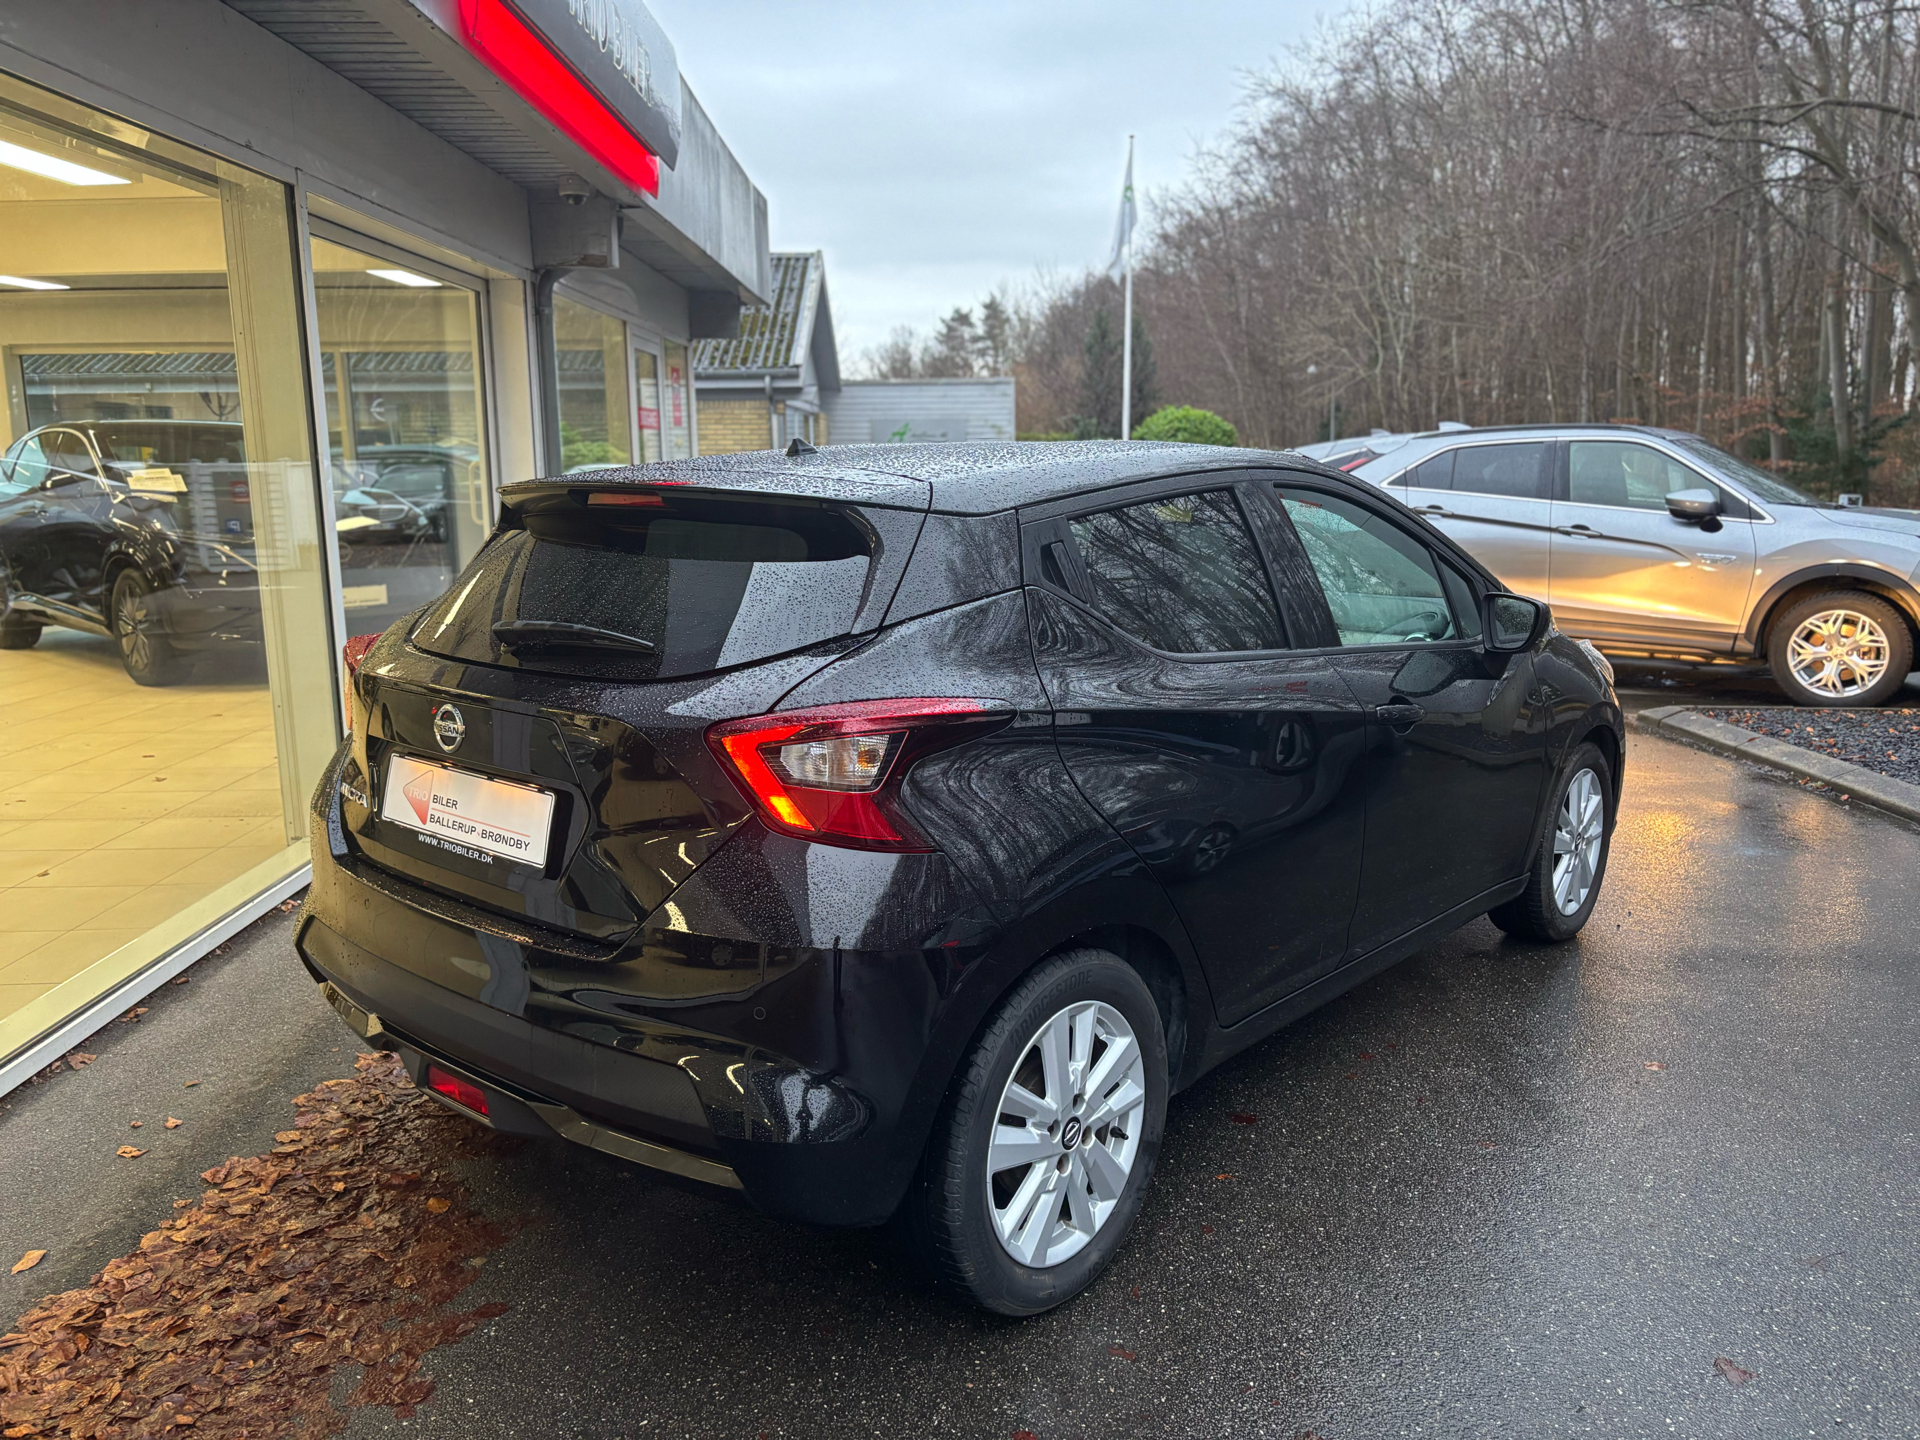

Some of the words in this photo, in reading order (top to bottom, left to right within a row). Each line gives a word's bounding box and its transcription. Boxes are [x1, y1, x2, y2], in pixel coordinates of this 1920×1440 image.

[409, 787, 429, 802] TRIO
[432, 794, 458, 810] BILER
[418, 833, 494, 865] WWW.TRIOBILER.DK
[429, 813, 477, 835] BALLERUP
[480, 828, 531, 851] BRØNDBY
[1009, 969, 1093, 1051] BRIDGESTONE
